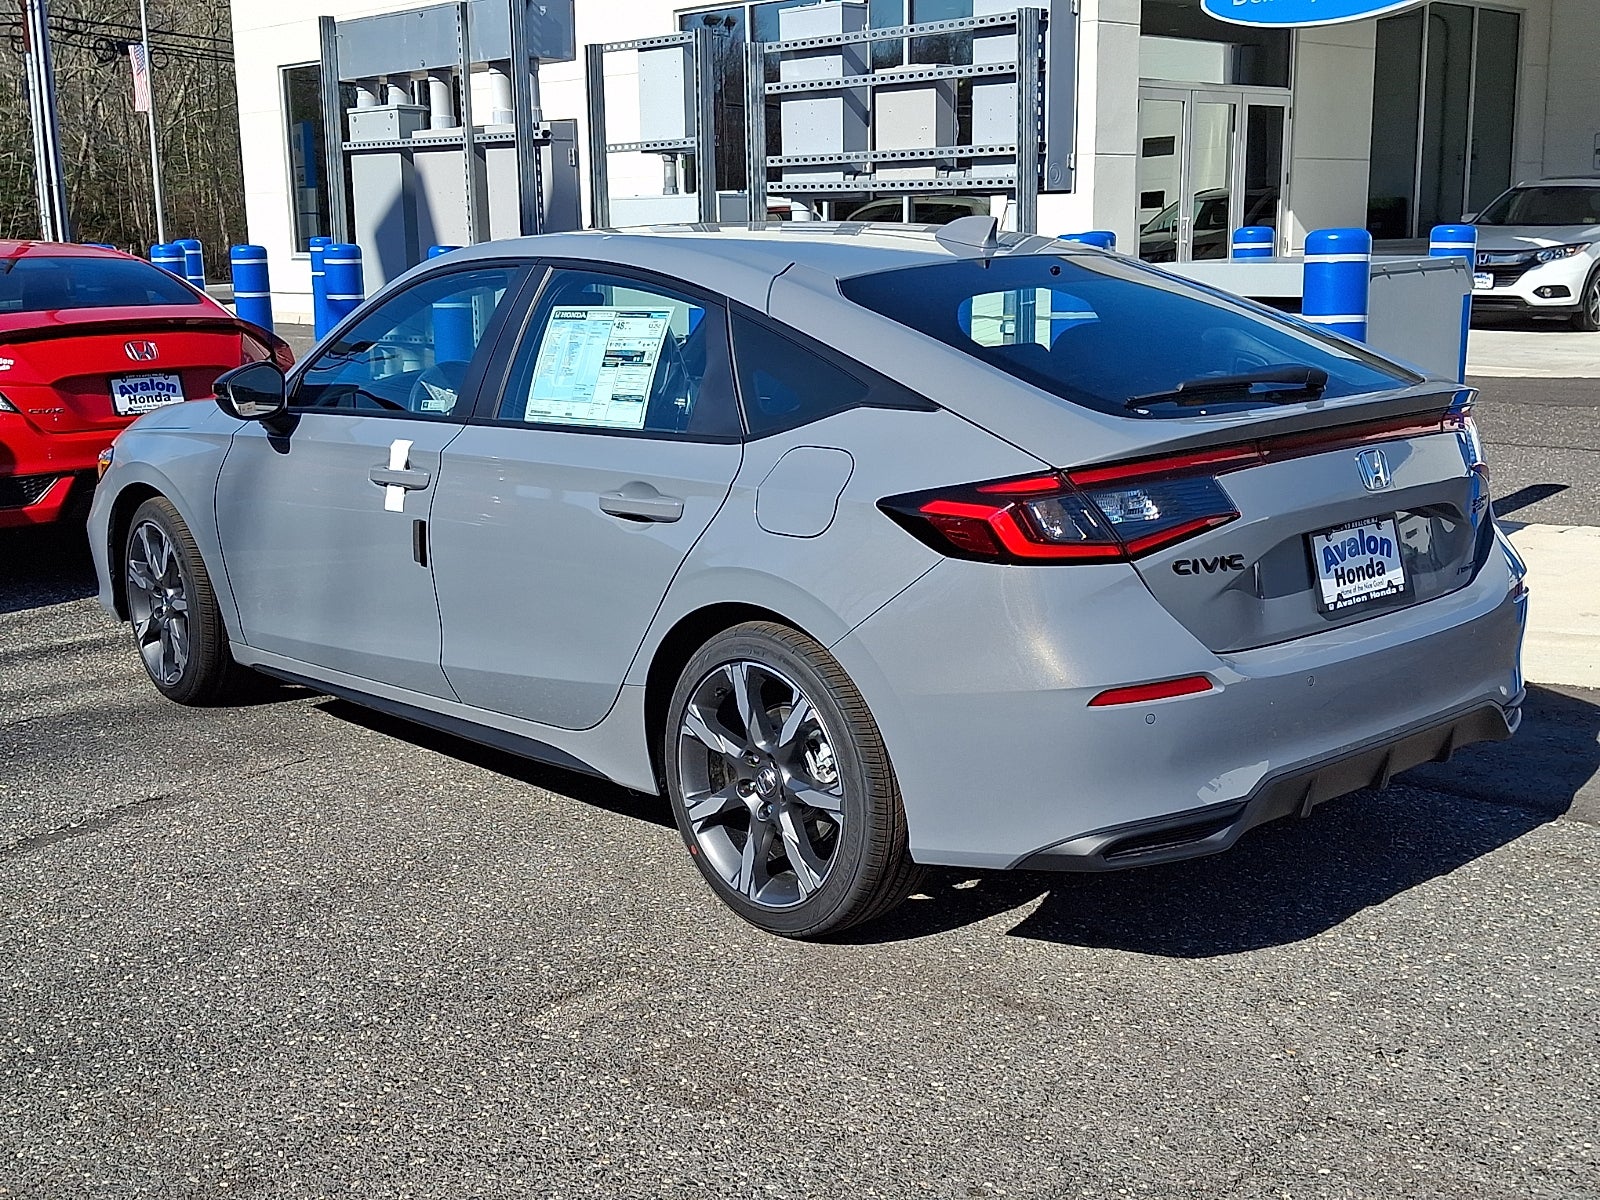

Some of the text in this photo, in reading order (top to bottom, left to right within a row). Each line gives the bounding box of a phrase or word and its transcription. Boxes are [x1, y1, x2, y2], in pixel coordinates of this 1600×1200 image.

[562, 311, 587, 319] HONDA
[118, 378, 177, 397] Avalon
[128, 392, 171, 405] Honda
[1322, 528, 1392, 574] Avalon
[1172, 553, 1245, 576] CIVIC
[1334, 557, 1386, 588] Honda
[1336, 587, 1397, 609] Avalon Honda
